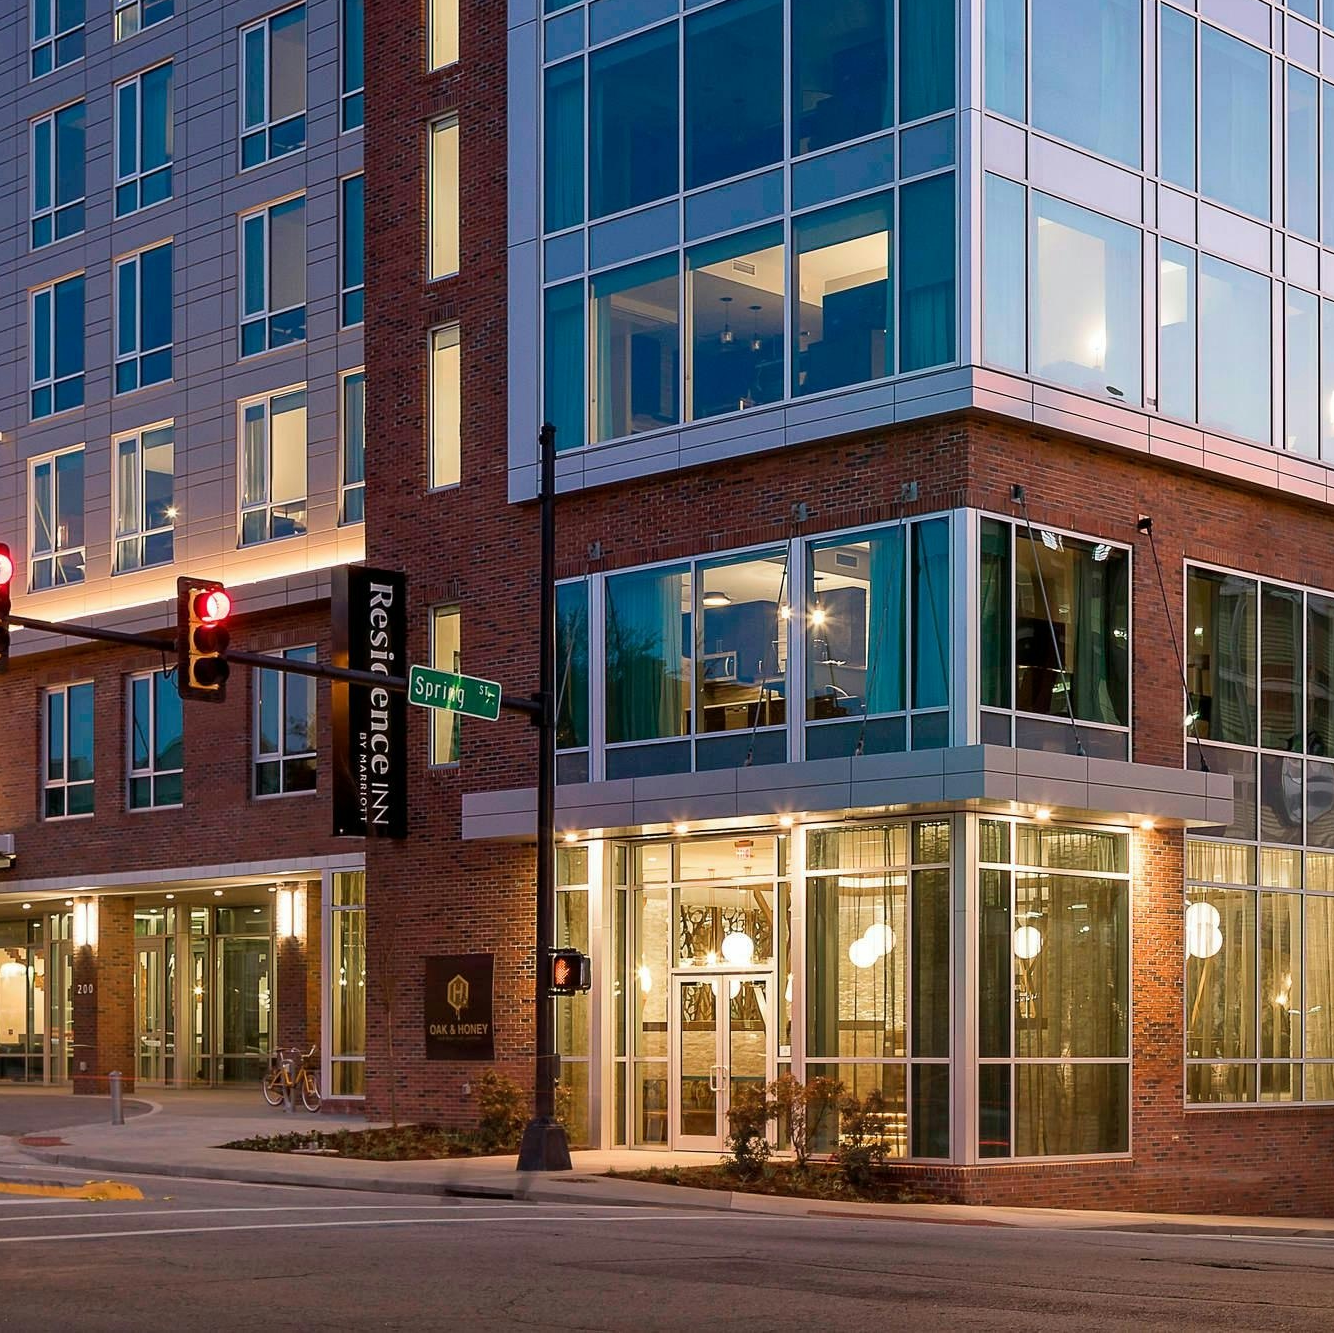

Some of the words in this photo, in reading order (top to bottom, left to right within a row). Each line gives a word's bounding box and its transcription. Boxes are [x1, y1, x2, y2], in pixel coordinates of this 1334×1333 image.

[415, 675, 465, 709] Spring
[359, 732, 367, 751] BY
[359, 753, 368, 822] MARRIOTT
[371, 782, 389, 825] INN
[77, 983, 94, 994] 200
[429, 1024, 448, 1035] OAK
[449, 1024, 456, 1035] &
[457, 1023, 488, 1035] HONEY
